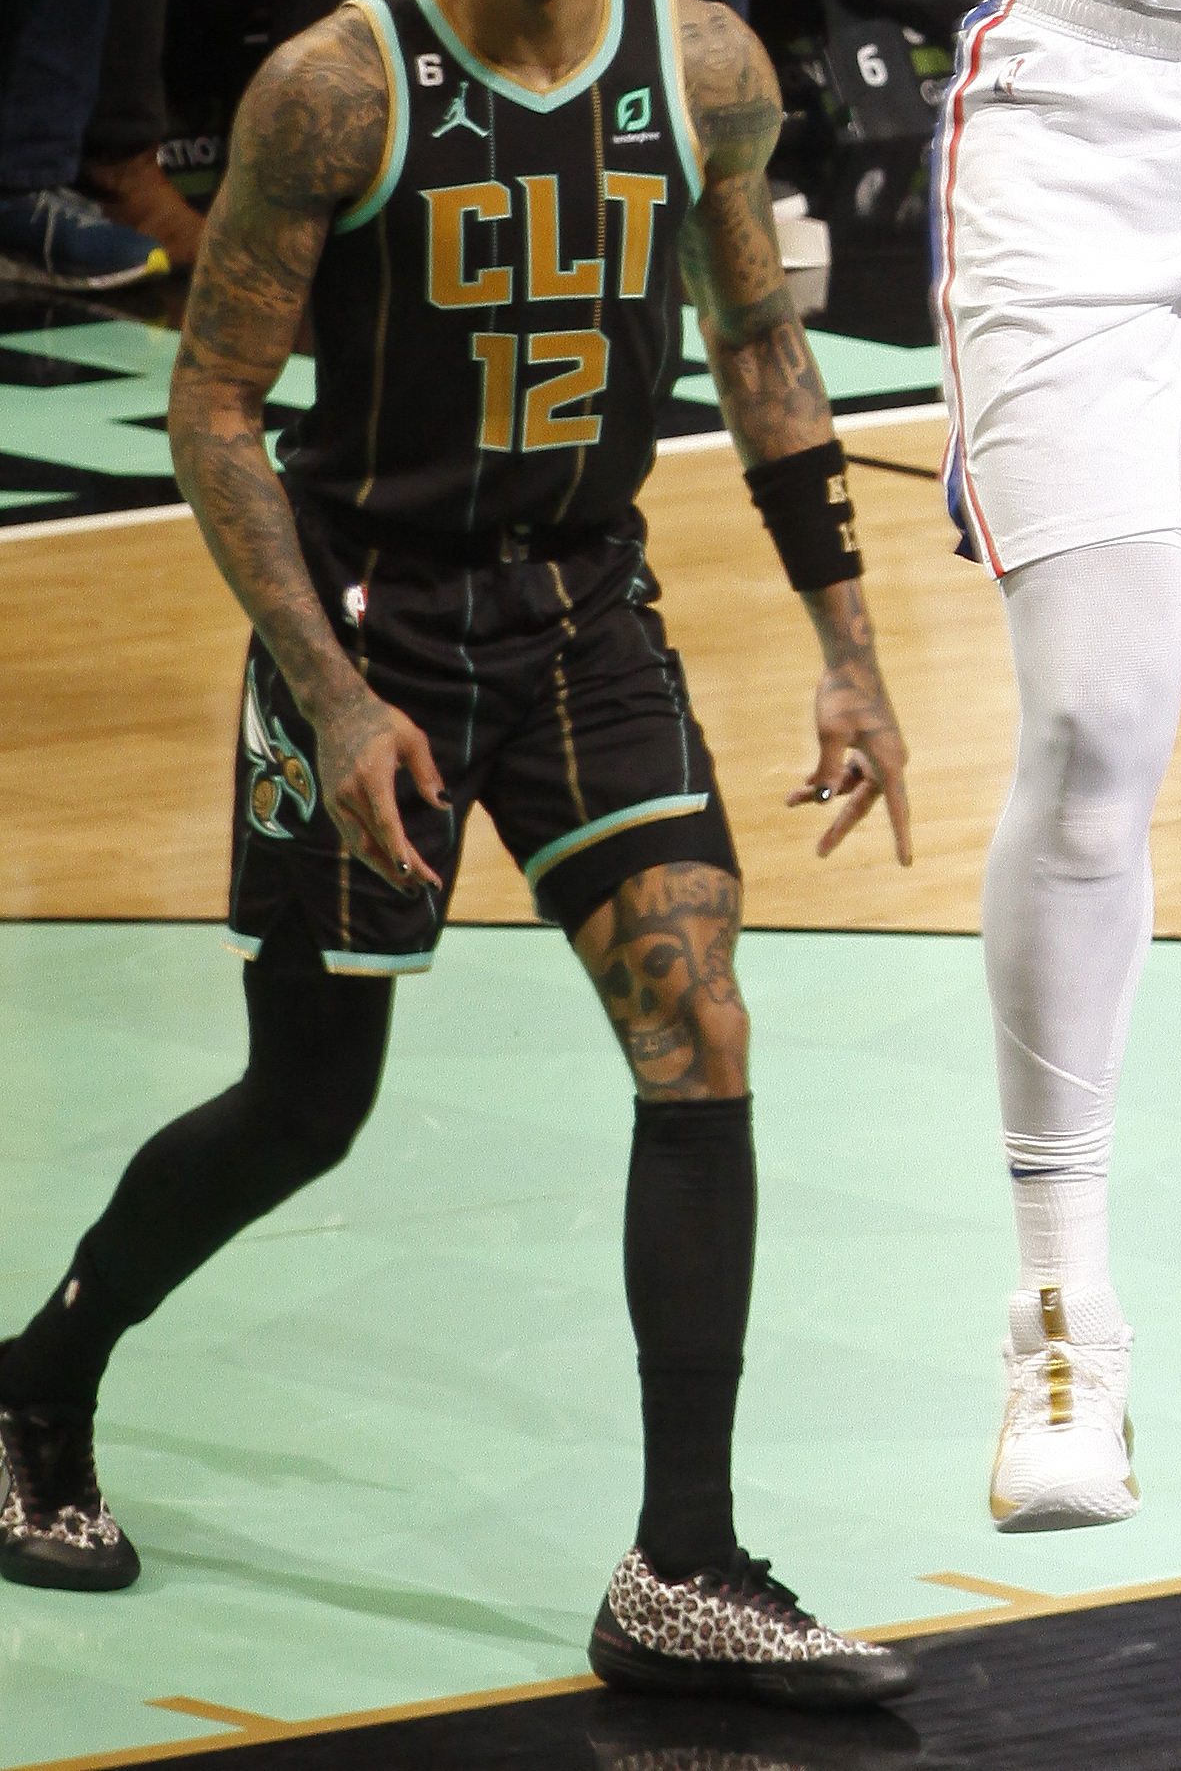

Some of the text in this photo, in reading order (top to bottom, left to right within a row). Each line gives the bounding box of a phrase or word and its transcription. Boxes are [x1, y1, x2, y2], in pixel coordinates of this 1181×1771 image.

[415, 53, 444, 87] 6
[857, 43, 888, 87] 6
[418, 170, 668, 309] CLT
[471, 328, 610, 453] 12
